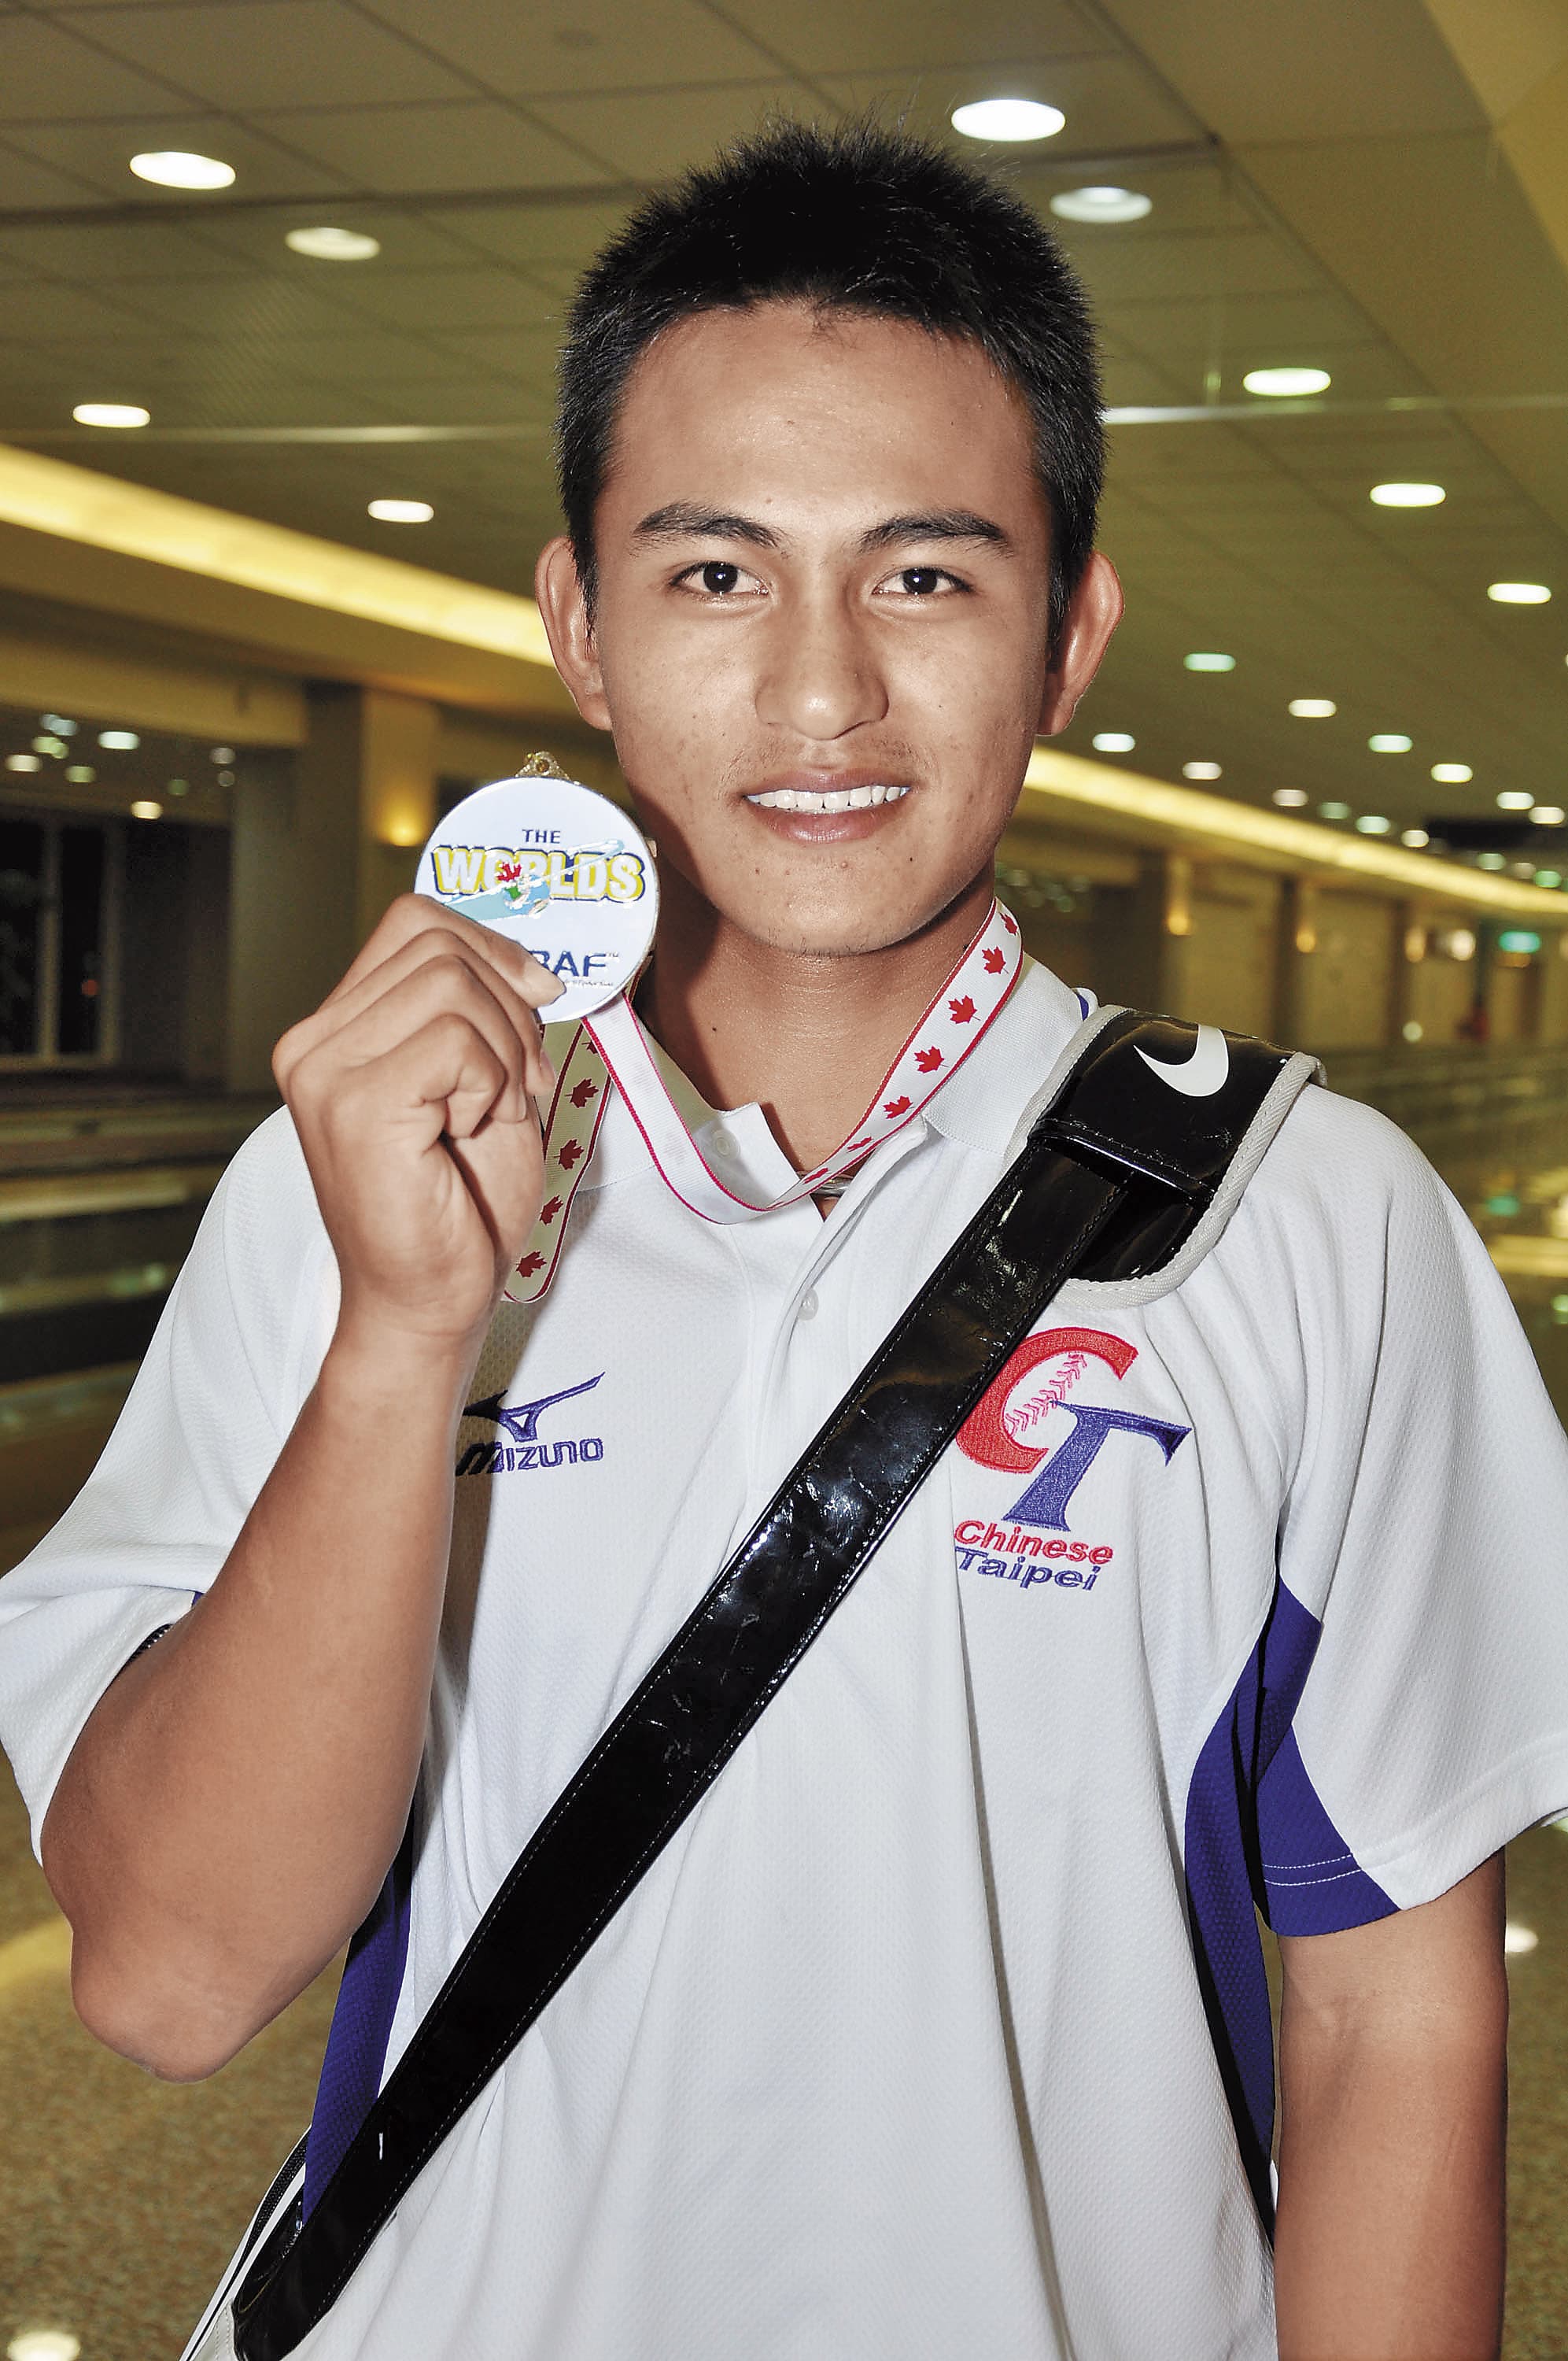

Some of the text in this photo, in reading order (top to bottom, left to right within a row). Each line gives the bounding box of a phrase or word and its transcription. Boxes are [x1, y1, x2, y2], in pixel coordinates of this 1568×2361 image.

[522, 829, 562, 844] THE
[431, 844, 646, 903] WORLDS
[455, 1437, 604, 1477] MIZUNO
[954, 1520, 1114, 1565] Chinese
[954, 1546, 1101, 1591] Taipei
